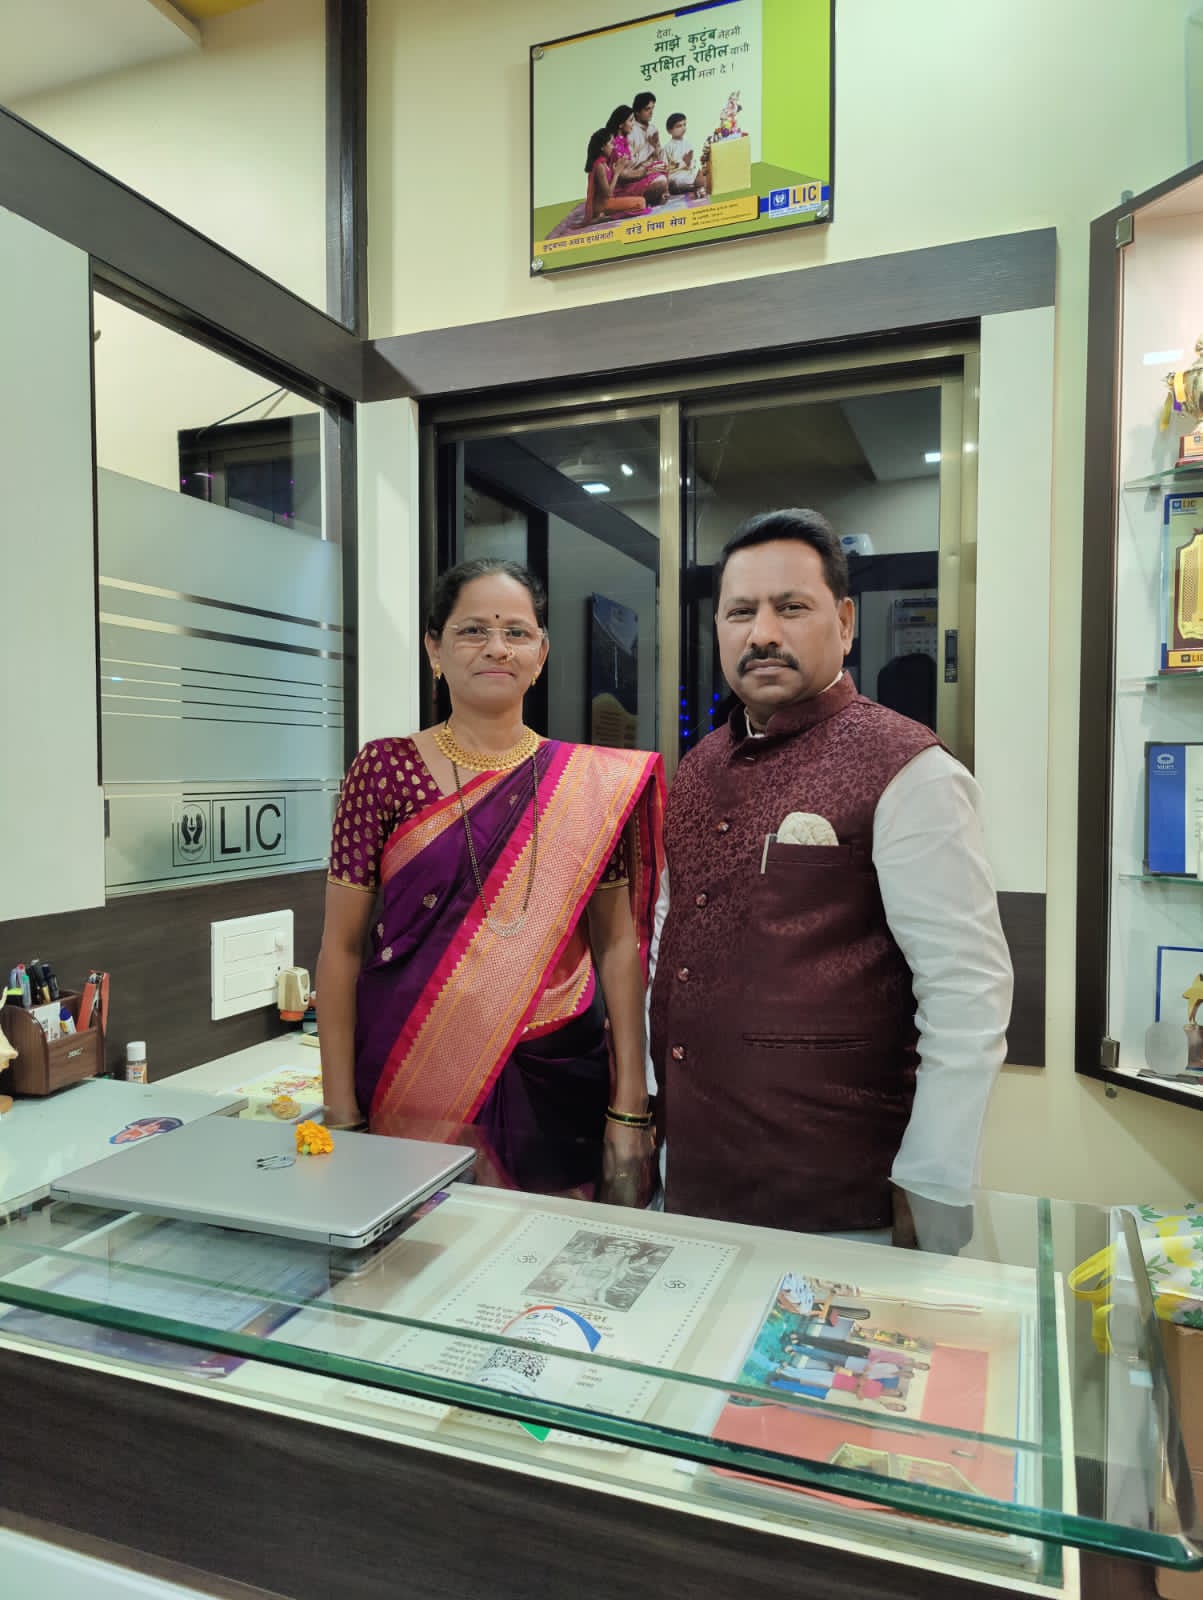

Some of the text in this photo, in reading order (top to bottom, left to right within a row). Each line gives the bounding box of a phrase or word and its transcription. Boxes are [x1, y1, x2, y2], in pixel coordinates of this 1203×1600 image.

[654, 34, 681, 53] माझे
[687, 26, 717, 51] कुटुंब
[639, 54, 687, 81] सुरक्षित
[693, 43, 729, 63] राहील
[671, 64, 696, 87] हमी
[793, 185, 817, 204] LIC
[220, 803, 282, 854] LIC
[542, 1313, 569, 1327] Pay
